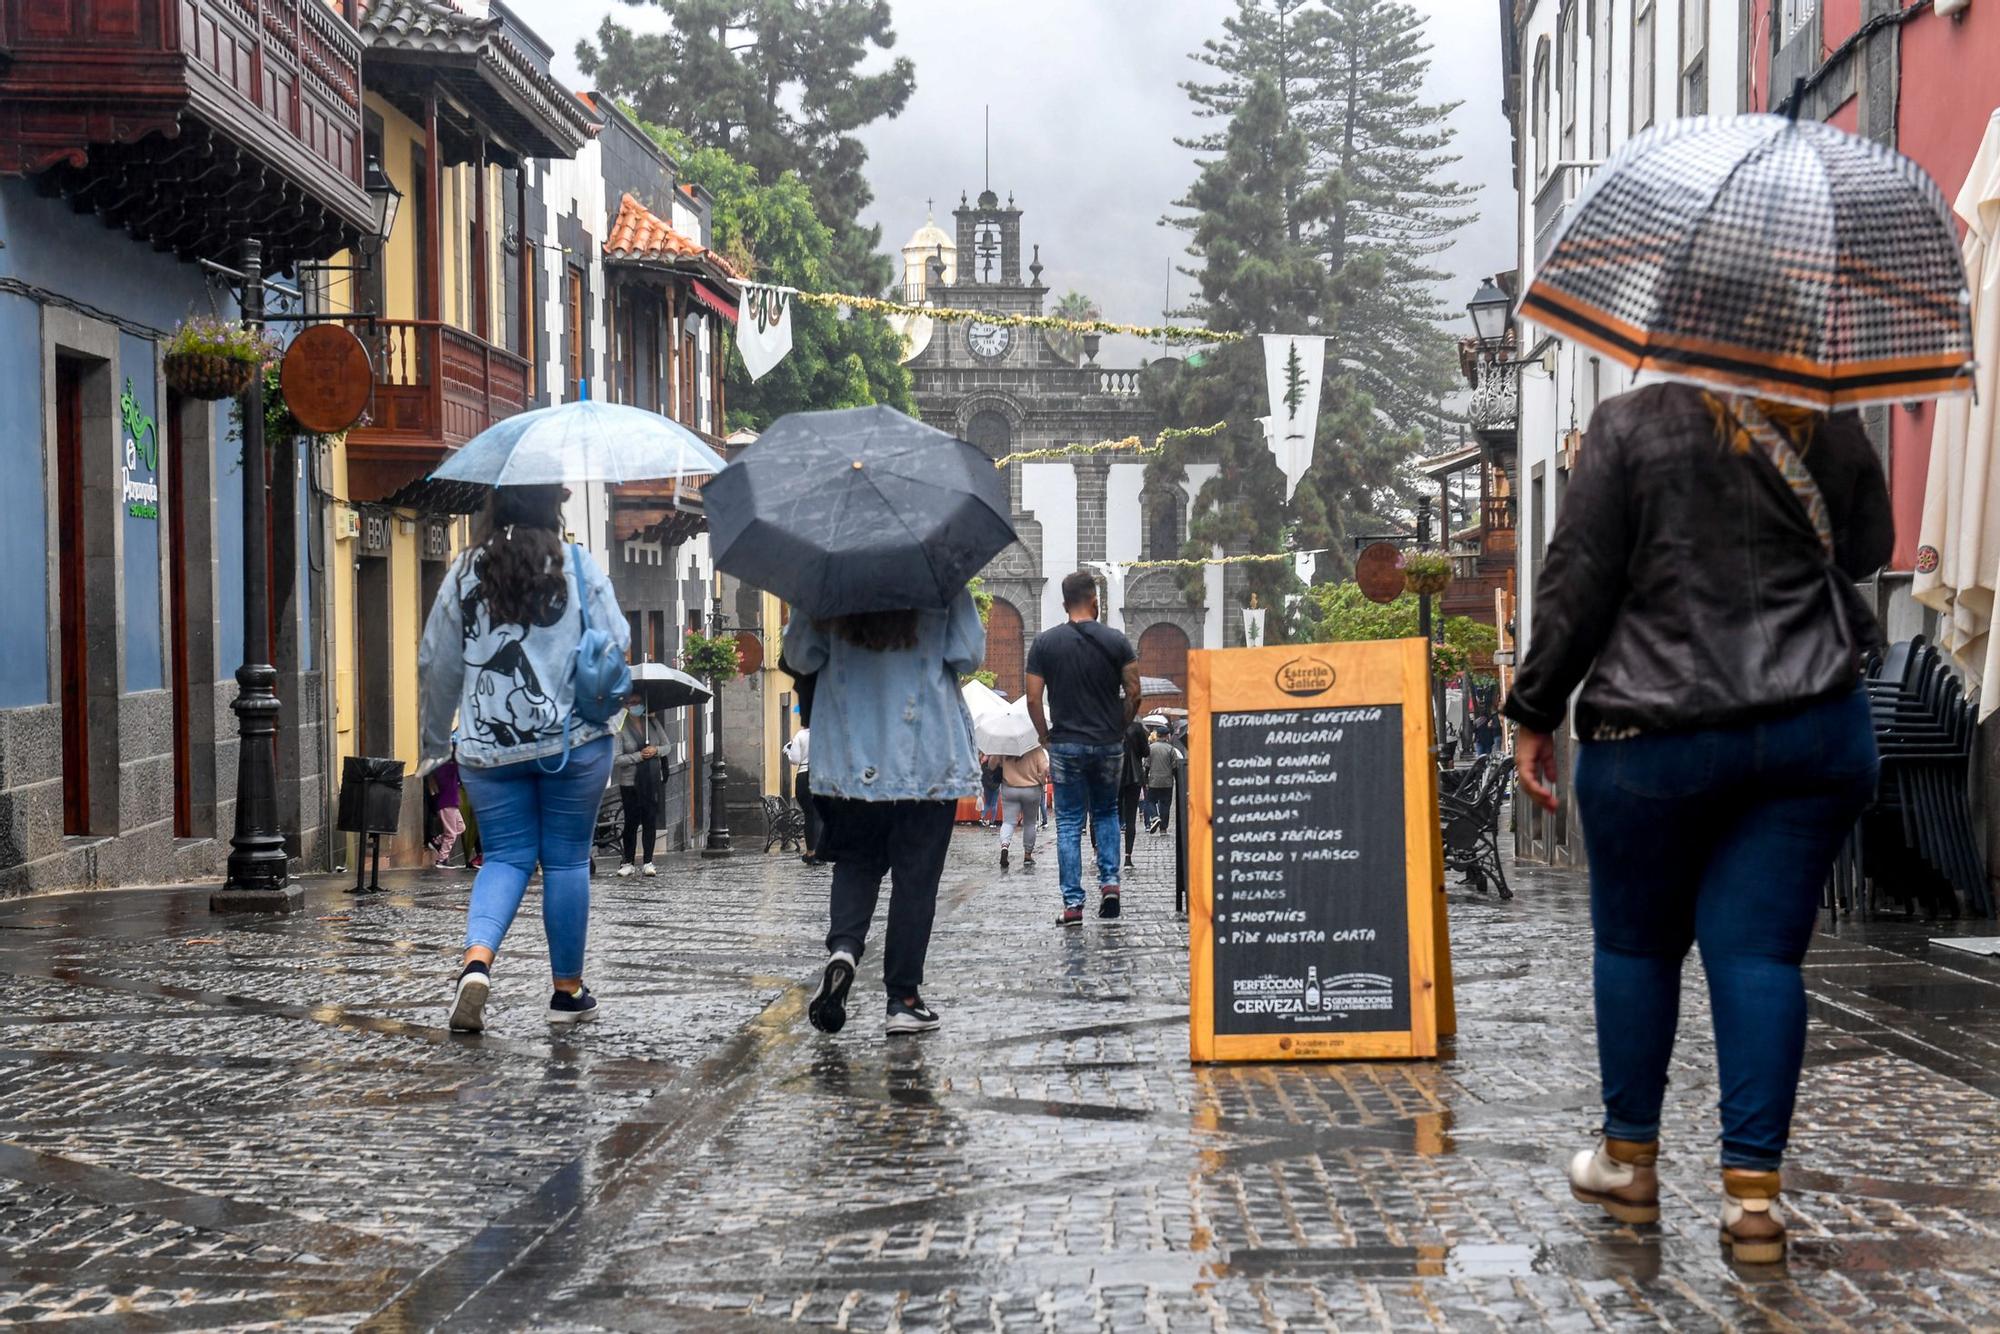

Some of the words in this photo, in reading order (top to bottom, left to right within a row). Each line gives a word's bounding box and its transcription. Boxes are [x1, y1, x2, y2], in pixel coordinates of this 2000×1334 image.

[368, 516, 392, 550] BBVA
[1284, 667, 1328, 678] Estrella
[1287, 677, 1326, 689] Galicia
[1218, 712, 1299, 728] RESTAURANTE
[1311, 708, 1382, 724] CAFETERÍA
[1265, 728, 1344, 745] ARAUCARIA
[1227, 756, 1272, 768] COMIDA
[1277, 752, 1331, 767] CANARIA
[1228, 774, 1271, 787] COMIDA
[1275, 770, 1337, 784] ESPAÑOLA
[1229, 809, 1299, 823] ENSALADAS
[1229, 830, 1276, 843] CARNES
[1230, 850, 1284, 863] PESCADO
[1290, 851, 1298, 863] Y
[1301, 847, 1360, 861] MARISCO
[1230, 868, 1284, 883] POSTRES
[1231, 888, 1286, 901] HELADOS
[1231, 907, 1307, 923] SMOOTHIES
[1231, 930, 1261, 944] PIDE
[1266, 930, 1326, 944] NUESTRA
[1332, 929, 1376, 942] CARTA
[1233, 976, 1304, 991] PERFECCIÓN
[1233, 998, 1304, 1013] CERVEZA
[1322, 998, 1333, 1011] 5
